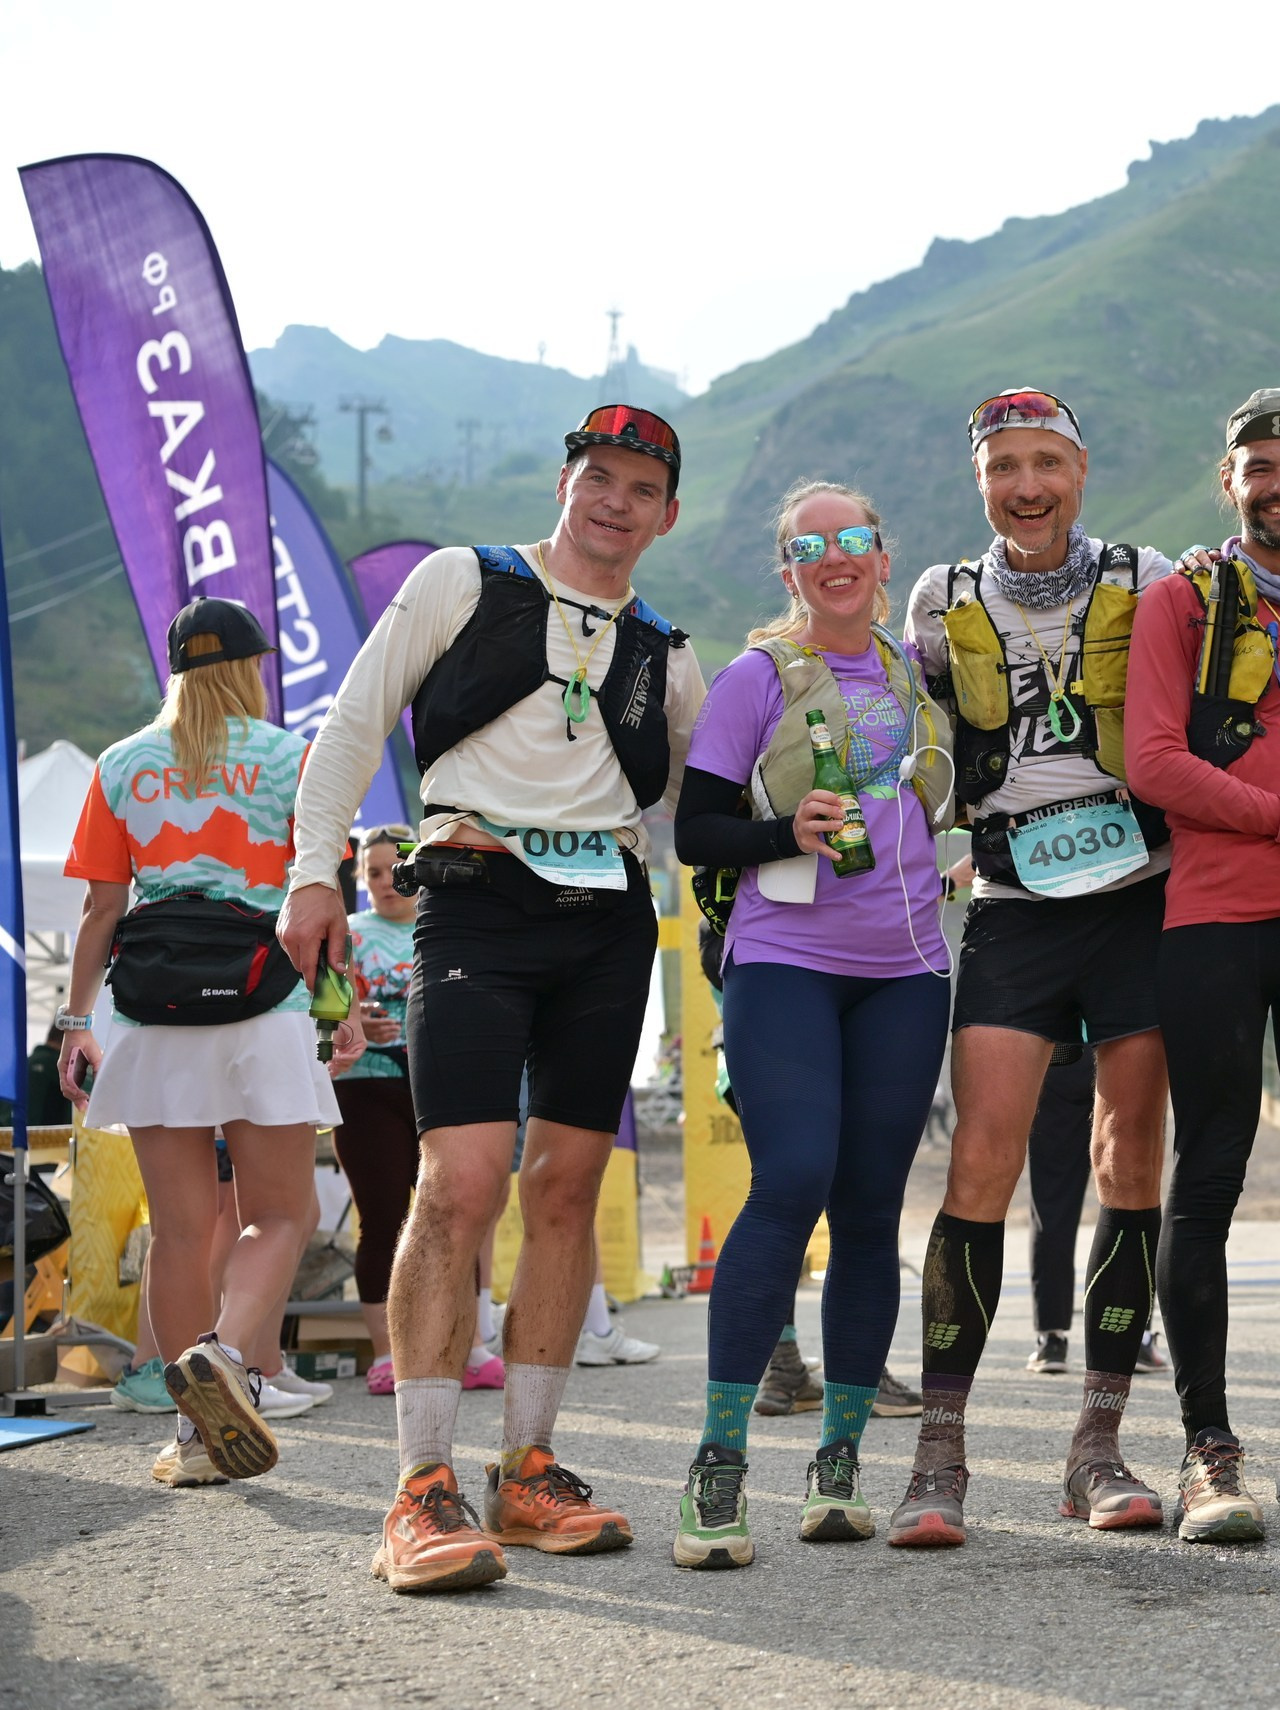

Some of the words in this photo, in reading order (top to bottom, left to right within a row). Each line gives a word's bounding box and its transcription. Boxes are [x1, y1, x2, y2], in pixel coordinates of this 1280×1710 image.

[130, 763, 261, 804] CREW
[1026, 794, 1108, 824] NUTREND
[504, 827, 607, 858] 004
[1028, 822, 1126, 867] 4030
[555, 894, 594, 904] AONIJIE
[212, 988, 239, 996] BASK
[1099, 1322, 1129, 1334] cep
[924, 1338, 953, 1350] cep
[1085, 1386, 1128, 1413] Triatle
[922, 1406, 964, 1426] atleta
